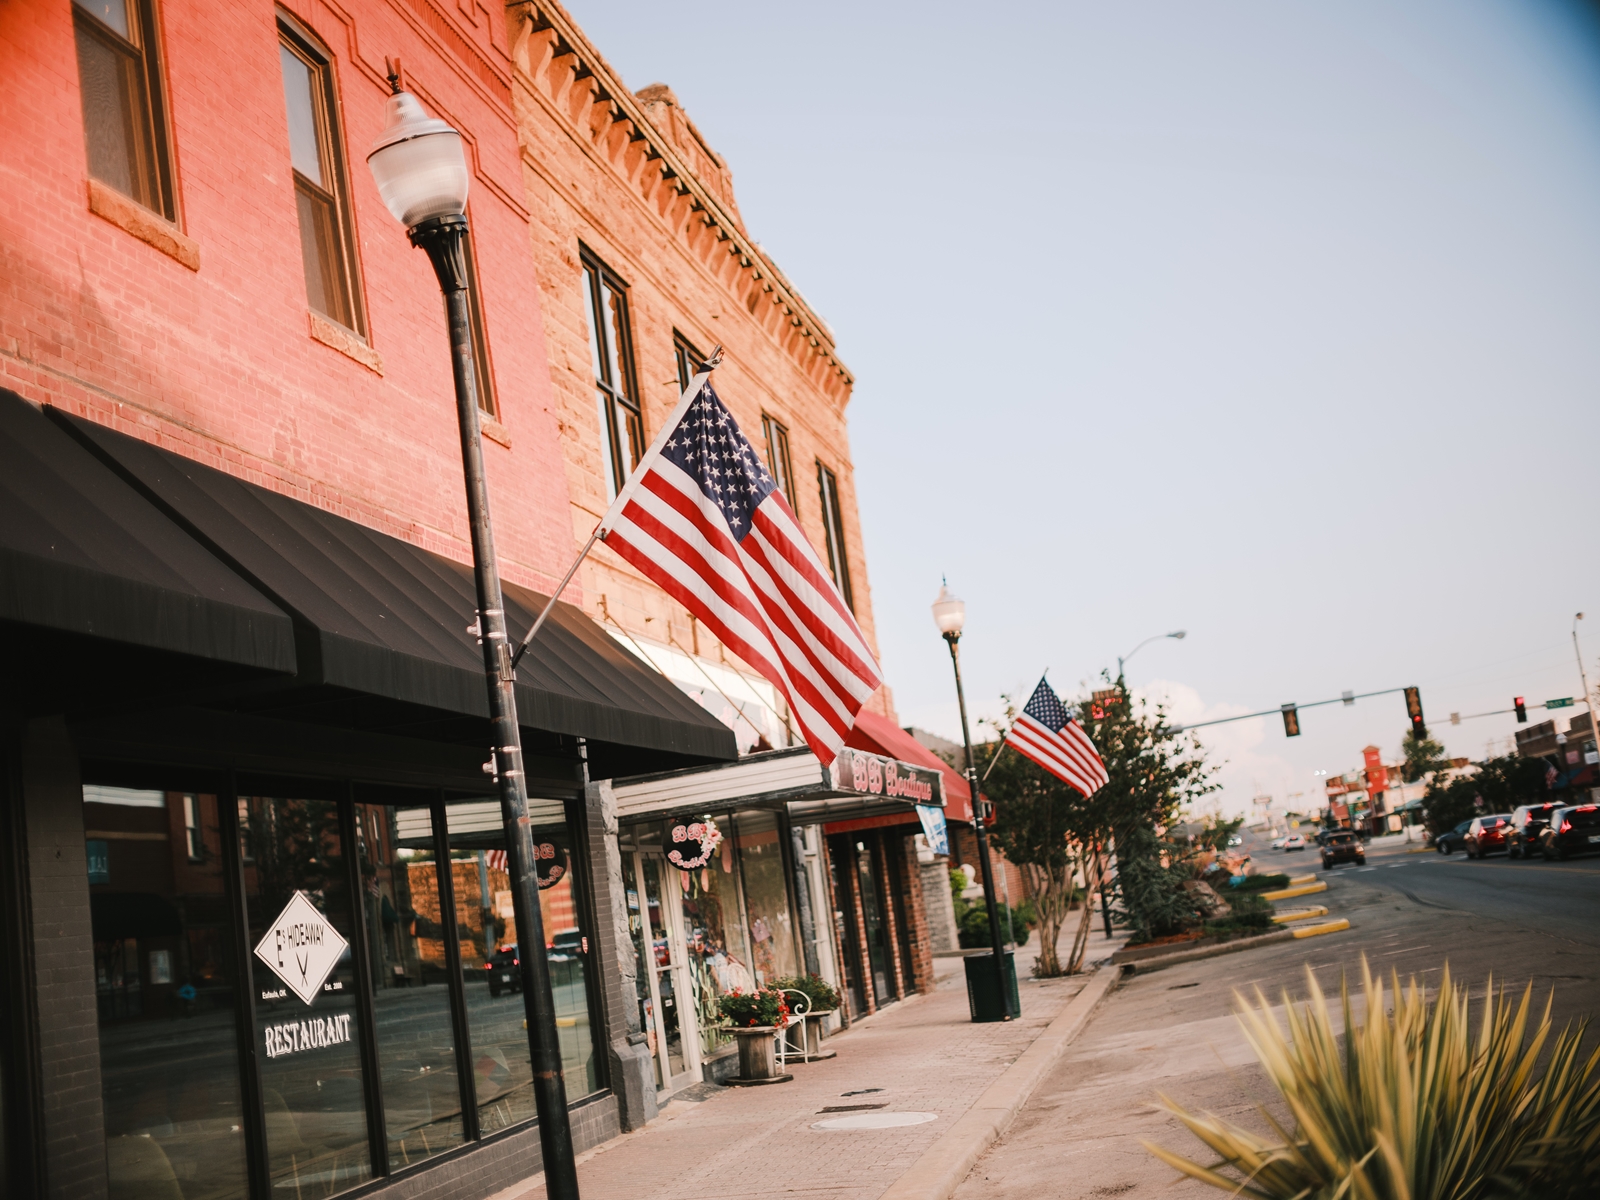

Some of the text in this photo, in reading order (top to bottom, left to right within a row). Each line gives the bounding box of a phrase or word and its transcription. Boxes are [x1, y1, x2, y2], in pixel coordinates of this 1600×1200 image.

[885, 761, 932, 803] Boutique
[672, 823, 702, 843] BB
[287, 923, 325, 949] HIDEAWAY
[264, 1014, 351, 1058] RESTAURANT
